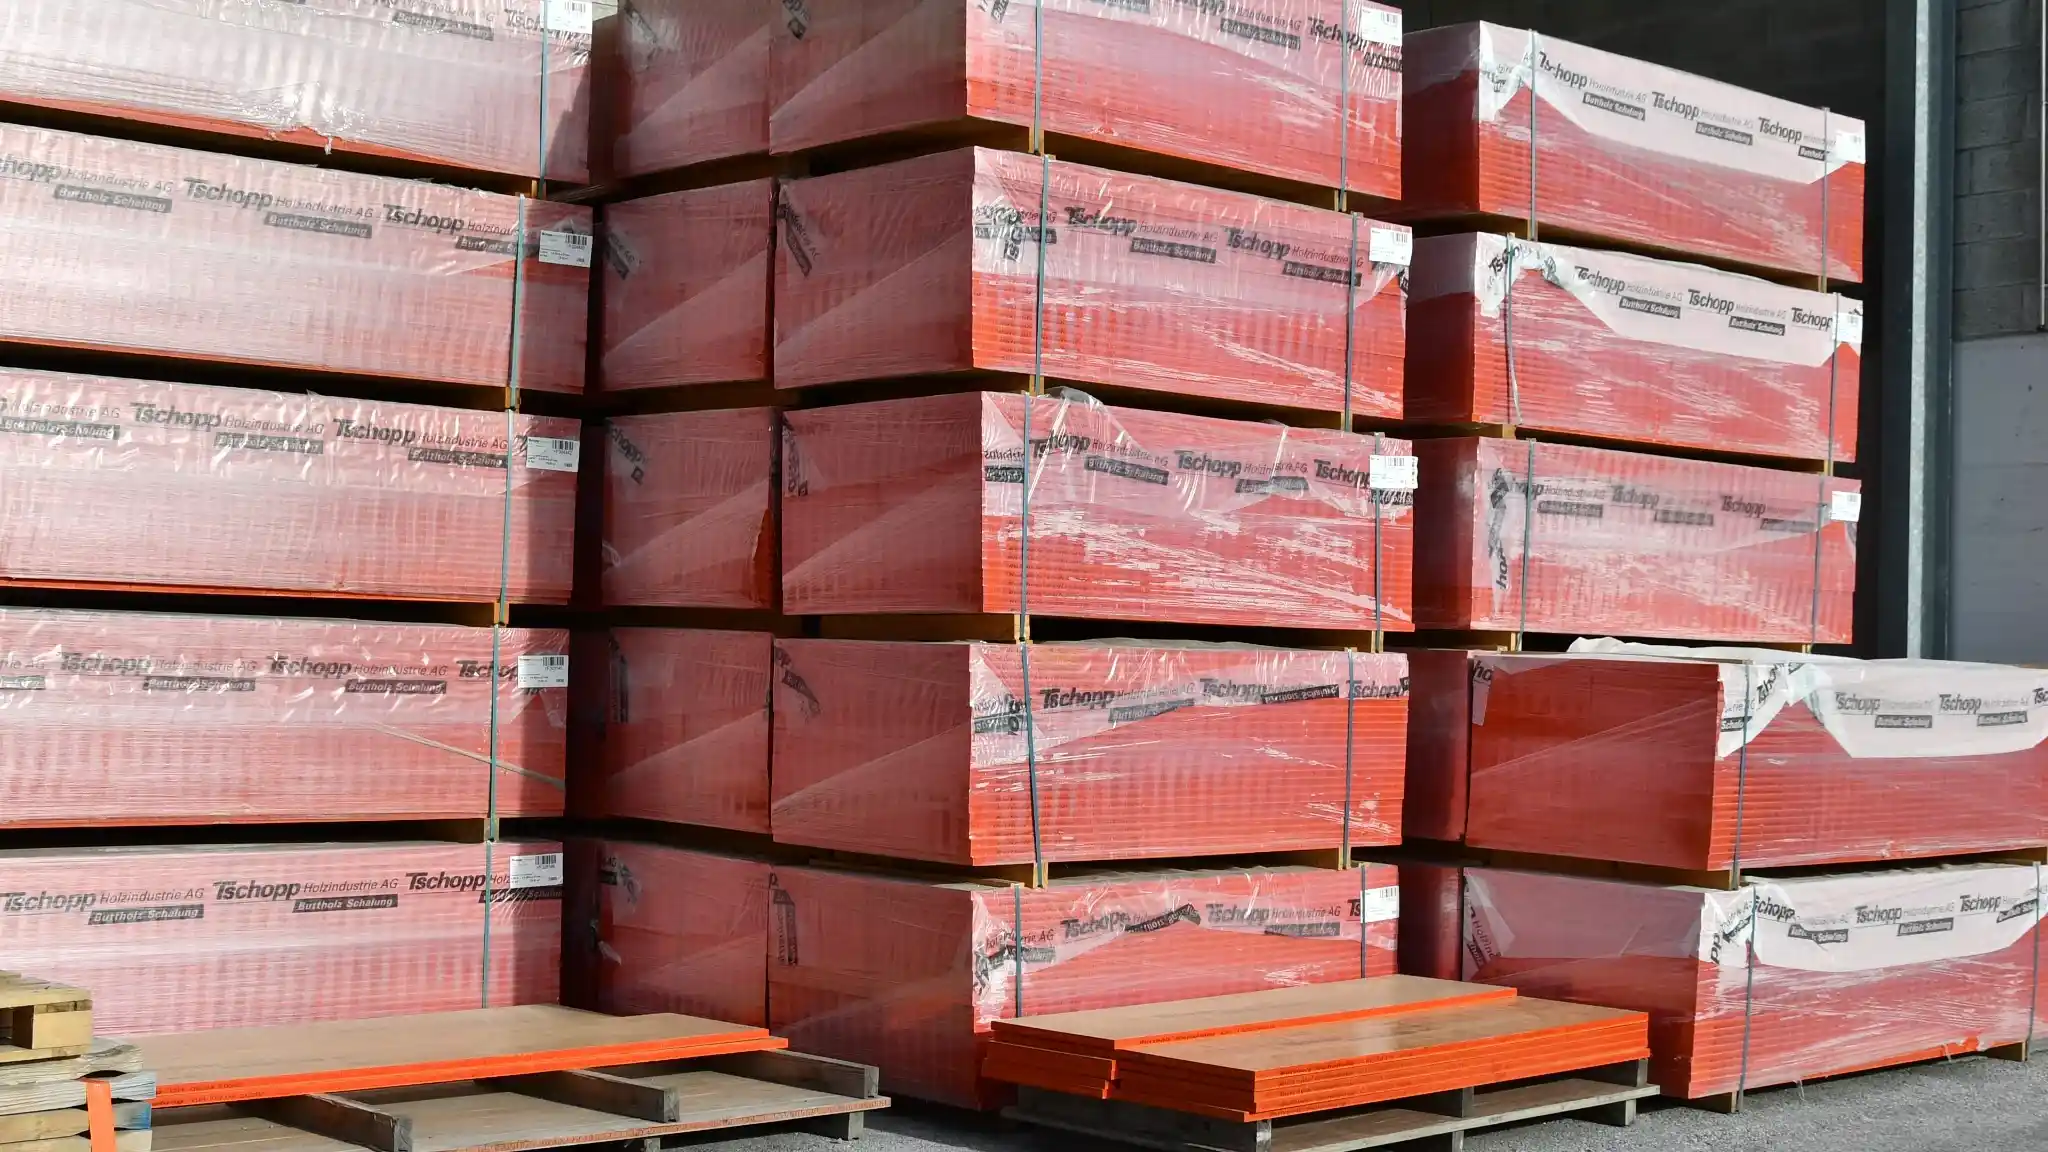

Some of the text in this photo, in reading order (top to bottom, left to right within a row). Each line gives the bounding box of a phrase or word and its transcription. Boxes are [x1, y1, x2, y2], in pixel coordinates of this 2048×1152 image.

[1288, 17, 1302, 31] AG
[1307, 16, 1368, 51] Tschpp
[1539, 51, 1588, 89] Tschopp
[1635, 91, 1648, 104] AG
[1652, 91, 1700, 121] Tschopp
[1758, 116, 1803, 145] Tschopp
[63, 167, 149, 189] Holzindustrie
[154, 180, 174, 194] AG
[184, 177, 375, 219] Tschopp Holzindustrie AG
[383, 203, 465, 235] Tschopp
[1064, 206, 1219, 243] Tschopp Holzindustrie AG
[1224, 226, 1291, 260] Tschopp
[1292, 245, 1349, 265] Holzindustrie
[1574, 265, 1626, 295] Tschopp
[1671, 291, 1684, 303] AG
[1688, 289, 1735, 315] Tschopp
[101, 406, 121, 419] AG
[131, 402, 326, 435] Tschopp Holzindustrie AG
[333, 418, 508, 450] Tschopp Holzindustrie AG
[1174, 449, 1242, 477] Tschopp
[1719, 494, 1766, 518] Tschopp
[60, 650, 152, 677] Tschopp
[238, 659, 257, 672] AG
[265, 655, 448, 679] Tschopp Holzindustrie AG
[1039, 686, 1115, 710] Tschopp
[1199, 678, 1267, 702] Tschopp
[1835, 691, 1881, 715] Tschopp
[1939, 693, 1982, 714] Tschopp
[212, 878, 400, 901] Tschopp Holzindustrie AG
[405, 871, 486, 892] Tschopp
[1, 887, 205, 913] Tschopp Holzindustrie AG
[298, 897, 393, 912] Buttholz Schalung
[1959, 894, 2002, 913] Tschopp
[93, 907, 199, 923] Buttholz Schalung
[1205, 903, 1270, 926] Tschopp
[1328, 904, 1342, 918] AG
[1854, 904, 1902, 925] Tschopp
[1038, 928, 1055, 943] AG
